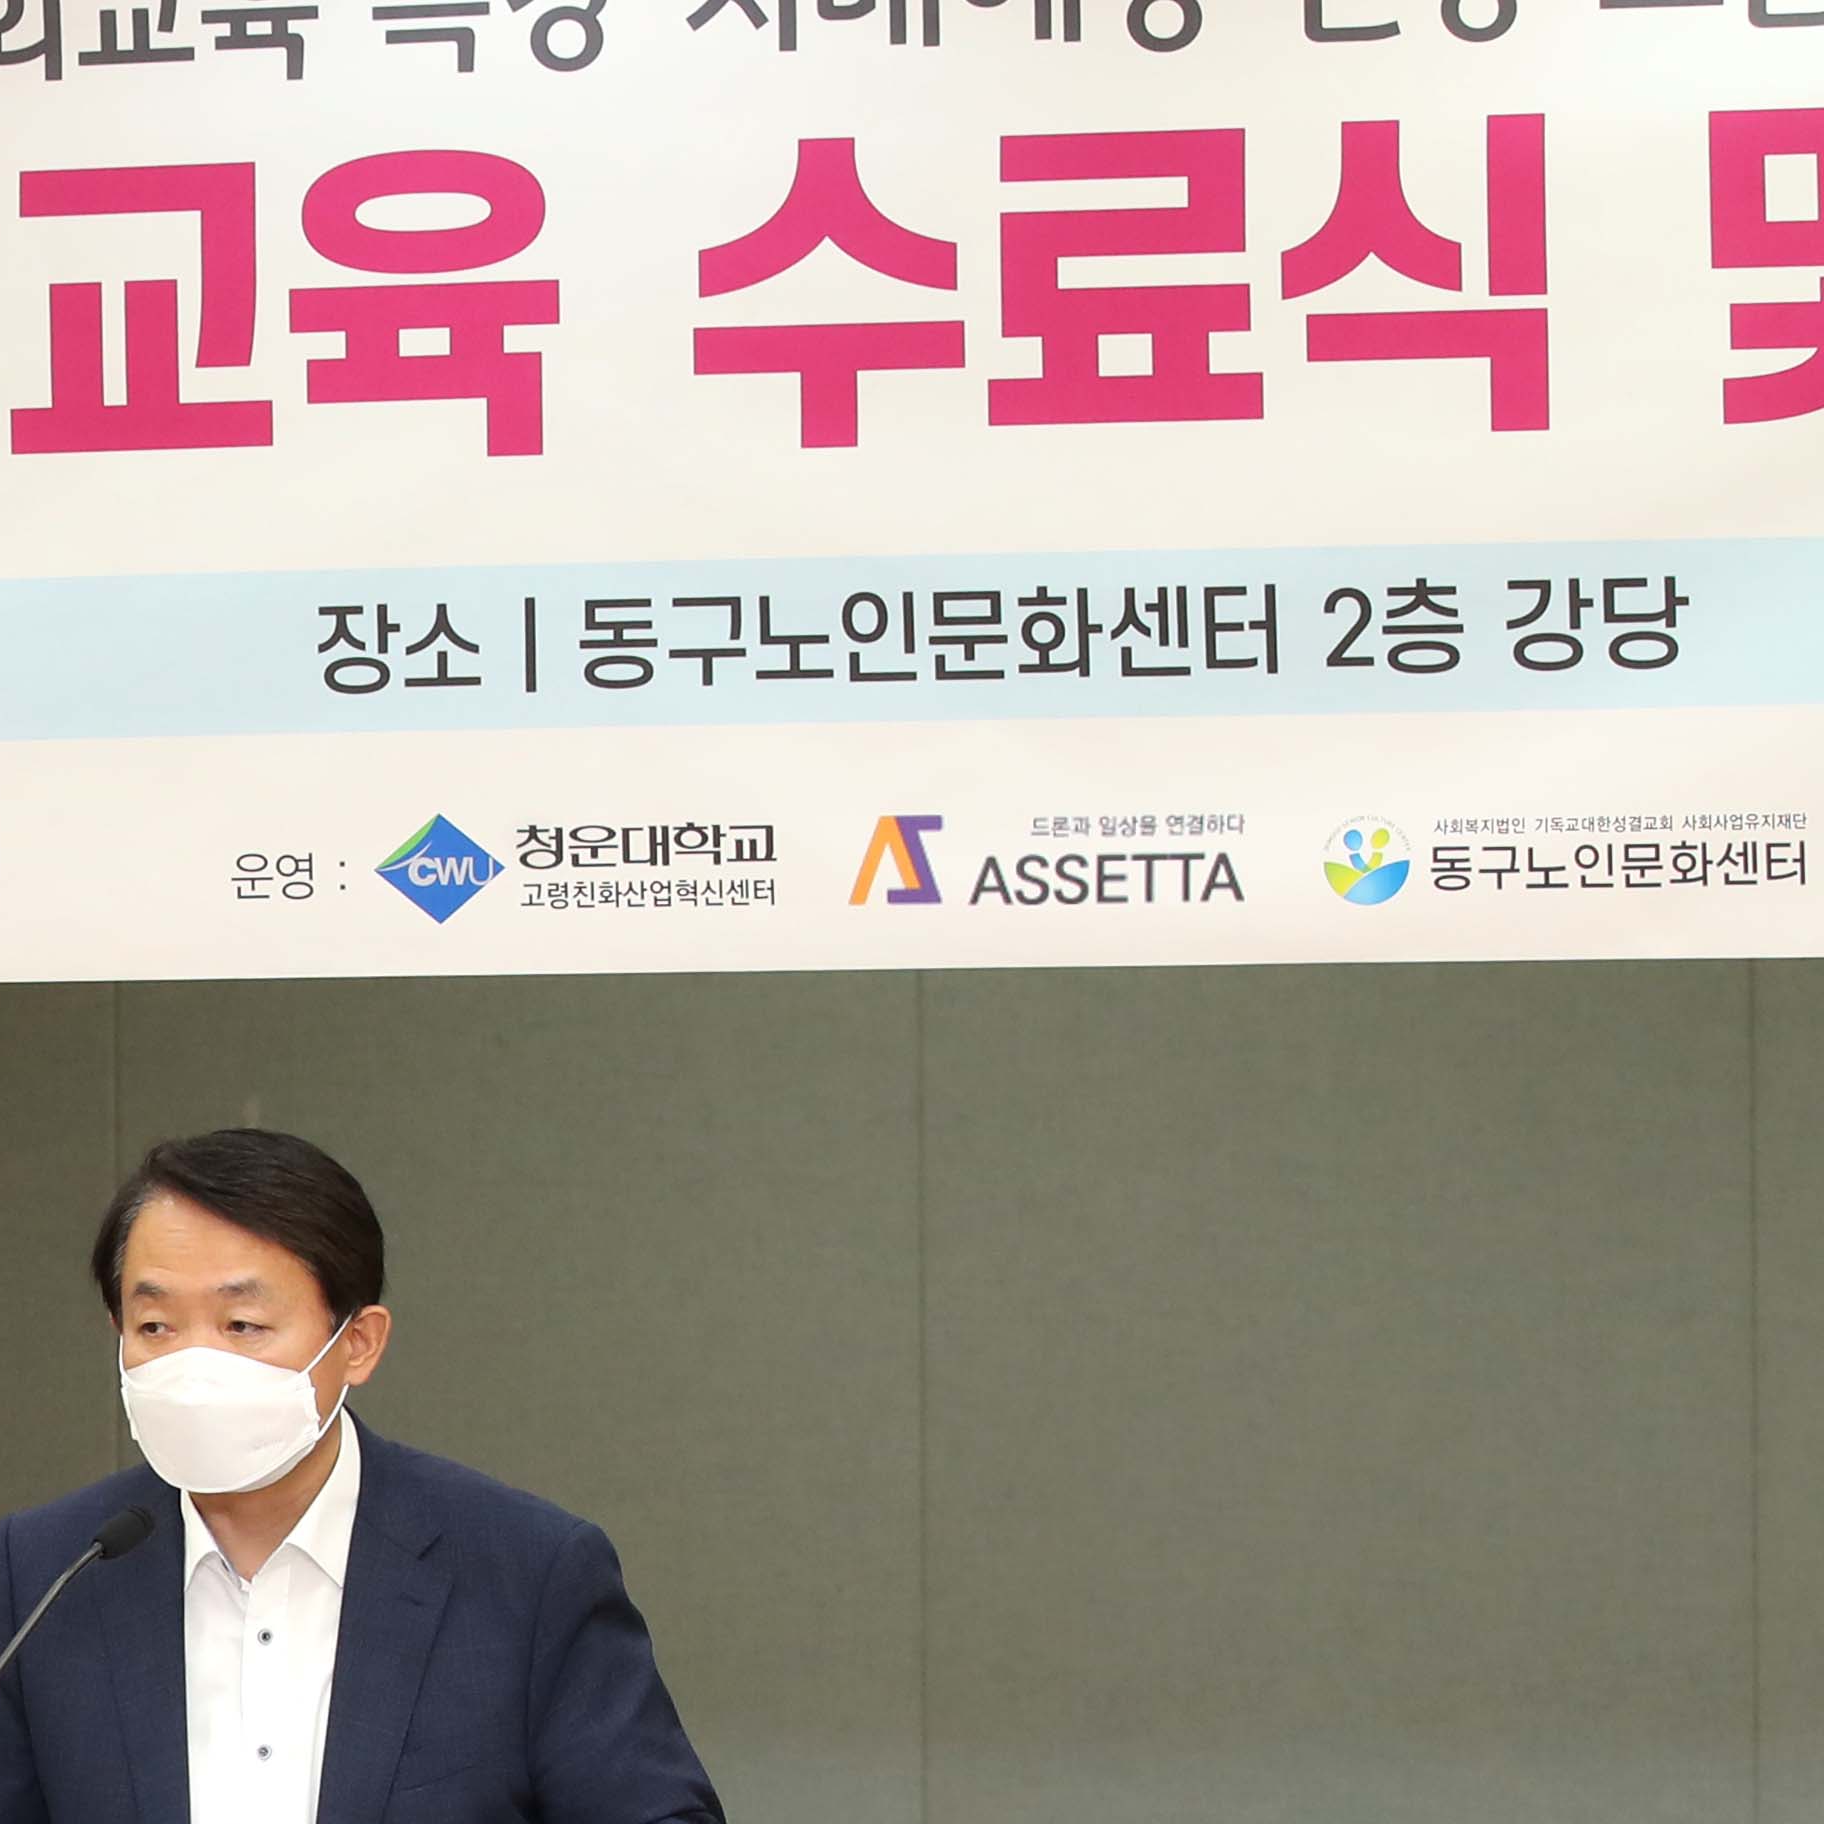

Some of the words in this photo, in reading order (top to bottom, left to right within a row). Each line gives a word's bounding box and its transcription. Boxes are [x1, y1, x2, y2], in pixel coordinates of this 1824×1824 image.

[9, 149, 561, 457] 교육
[692, 112, 1550, 449] 수료식
[317, 603, 482, 695] 장소
[579, 583, 1279, 690] 동구노인문화센터
[1323, 577, 1465, 674] 2층
[1506, 575, 1690, 672] 강당
[516, 821, 778, 870] 청운대학교
[1031, 816, 1091, 838] 드론과
[1098, 815, 1157, 837] 일상을
[1165, 814, 1245, 836] 연결하다
[1434, 817, 1526, 835] 사회복지법인
[1535, 814, 1673, 833] 기독교대한성결교회
[1681, 812, 1807, 831] 사회사업유지재단
[231, 852, 314, 900] 운영
[406, 854, 495, 888] CWU
[969, 852, 1245, 906] ASSETTA
[1430, 840, 1806, 892] 동구노인문화센터
[520, 878, 775, 910] 고령친화산업혁신센터
